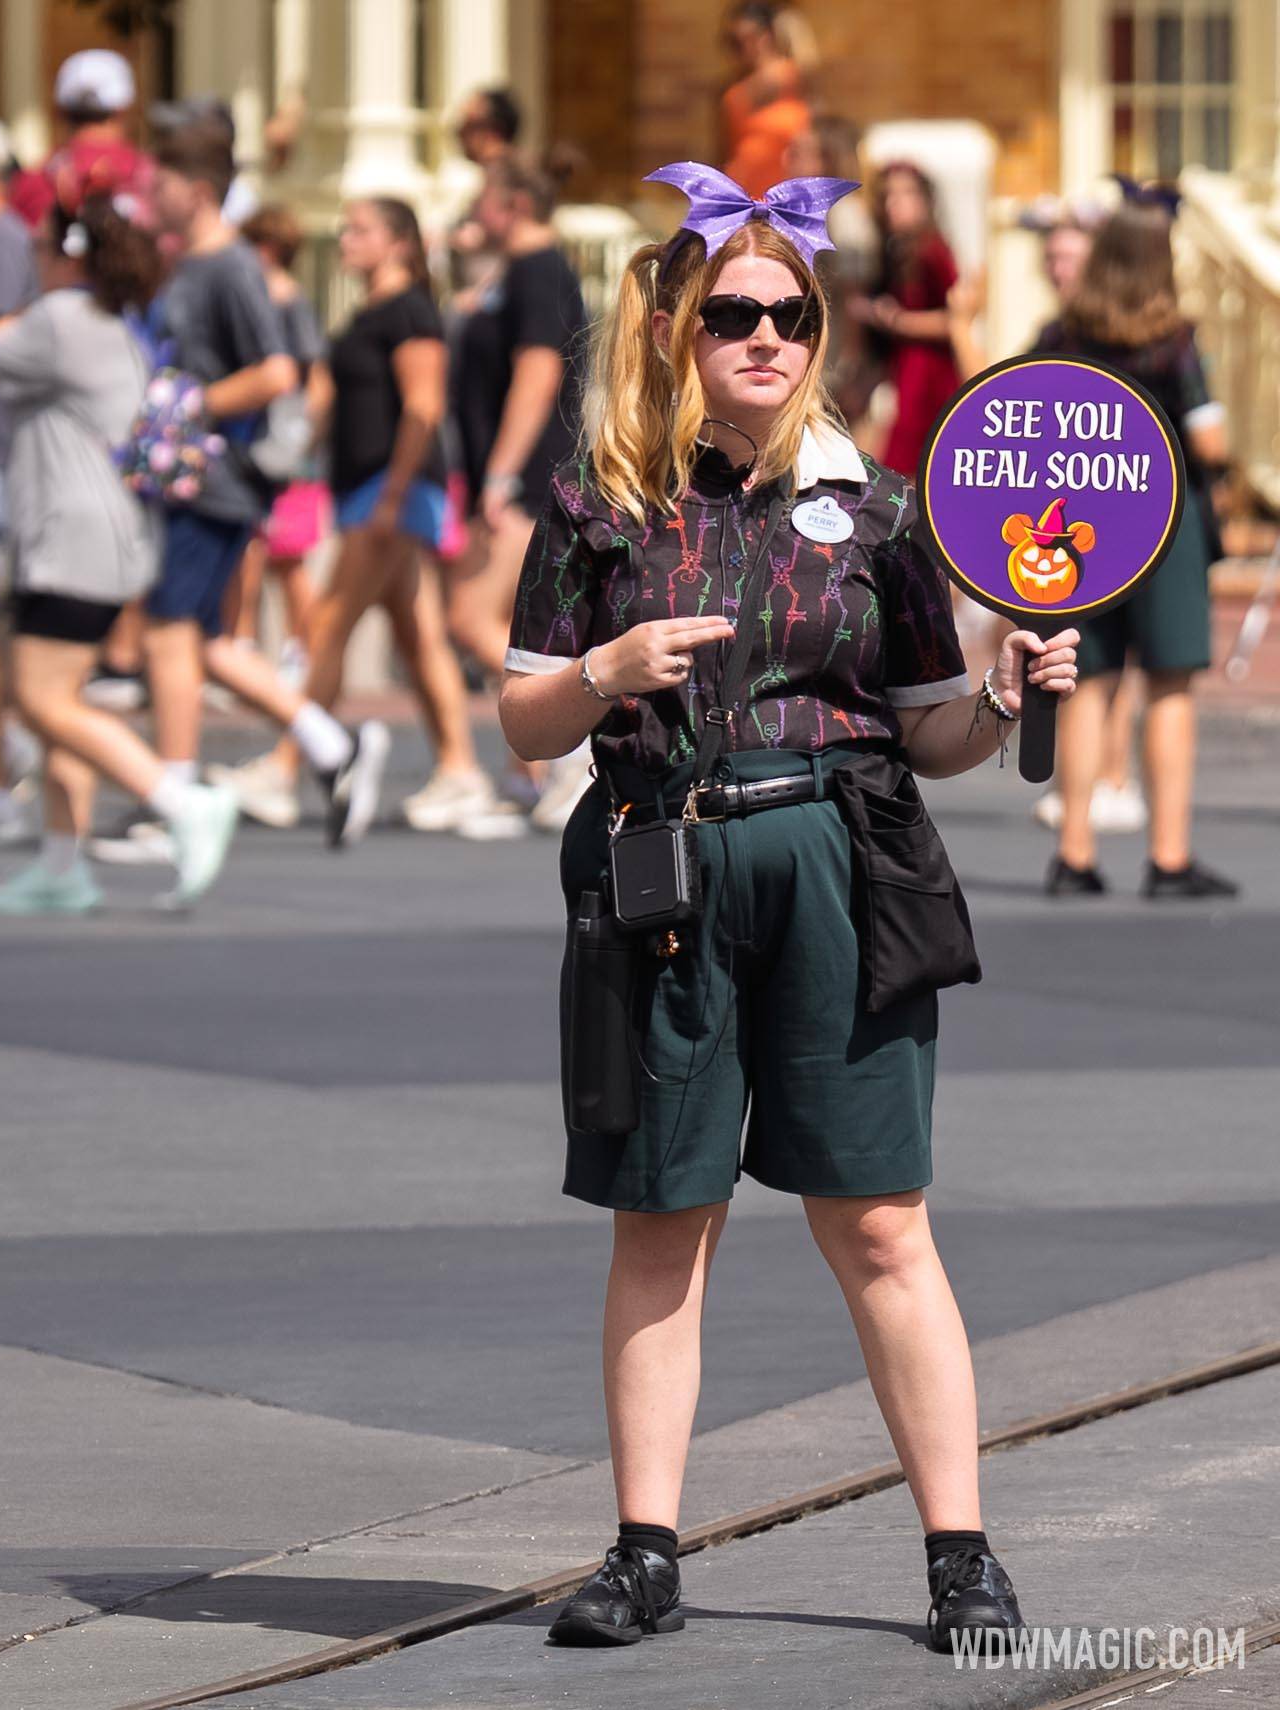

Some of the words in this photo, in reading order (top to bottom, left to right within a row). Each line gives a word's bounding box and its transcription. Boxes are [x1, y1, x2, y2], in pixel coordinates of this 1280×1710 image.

[982, 398, 1044, 439] SEE
[1054, 401, 1123, 441] YOU
[952, 448, 1038, 489] REAL
[1045, 451, 1151, 493] SOON!
[808, 514, 838, 528] PERRY
